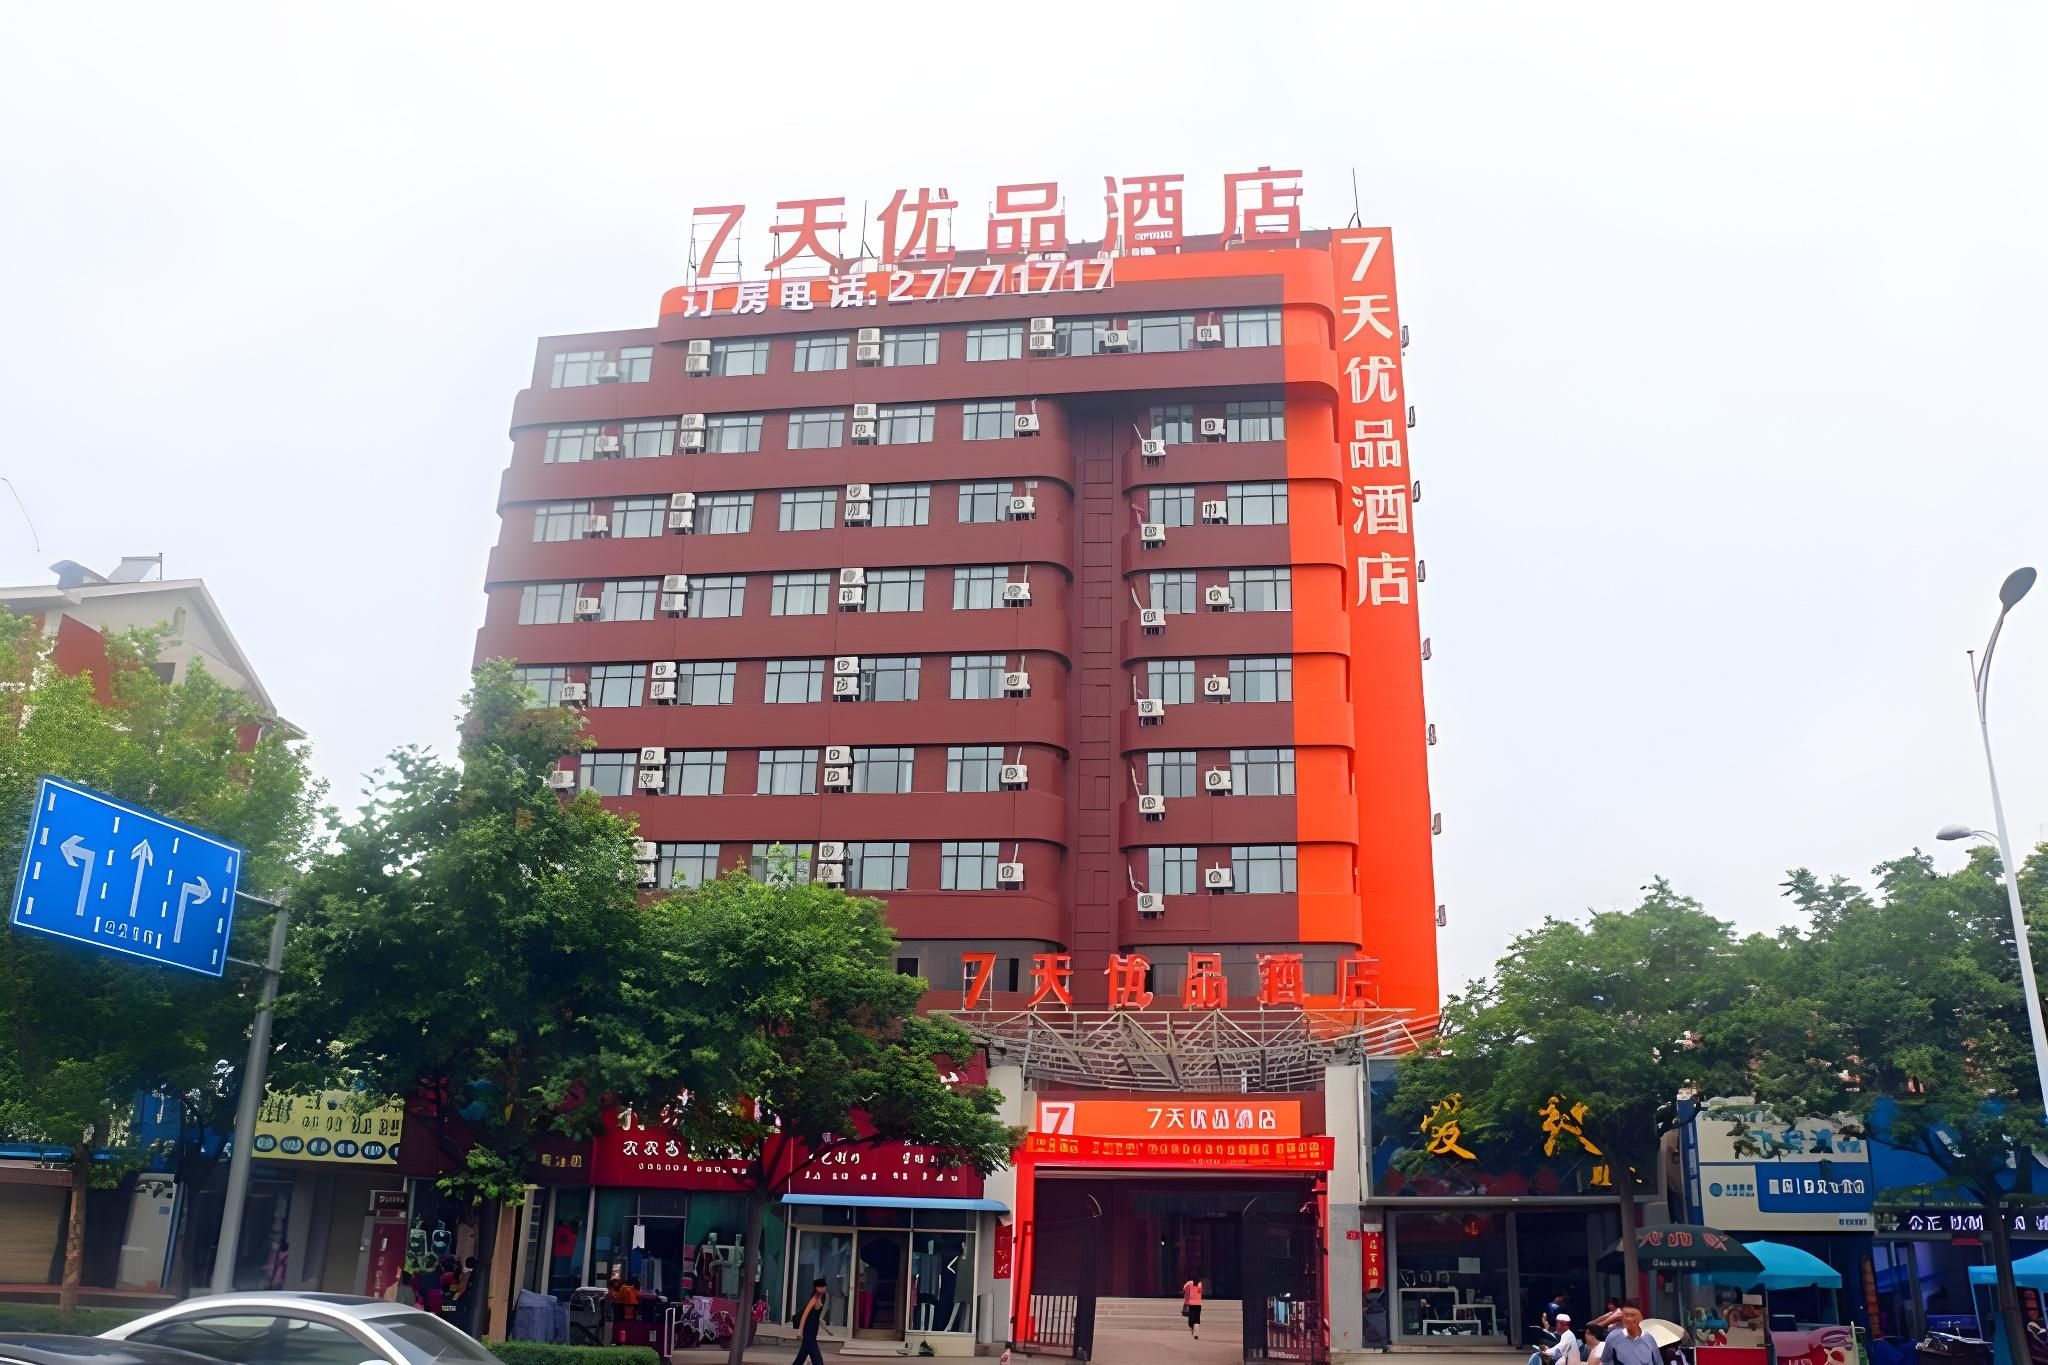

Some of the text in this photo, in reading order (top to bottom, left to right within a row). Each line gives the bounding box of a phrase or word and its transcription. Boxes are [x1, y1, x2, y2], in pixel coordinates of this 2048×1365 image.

[692, 166, 1303, 278] 7天优品酒店
[1341, 236, 1410, 607] 7天优品酒店
